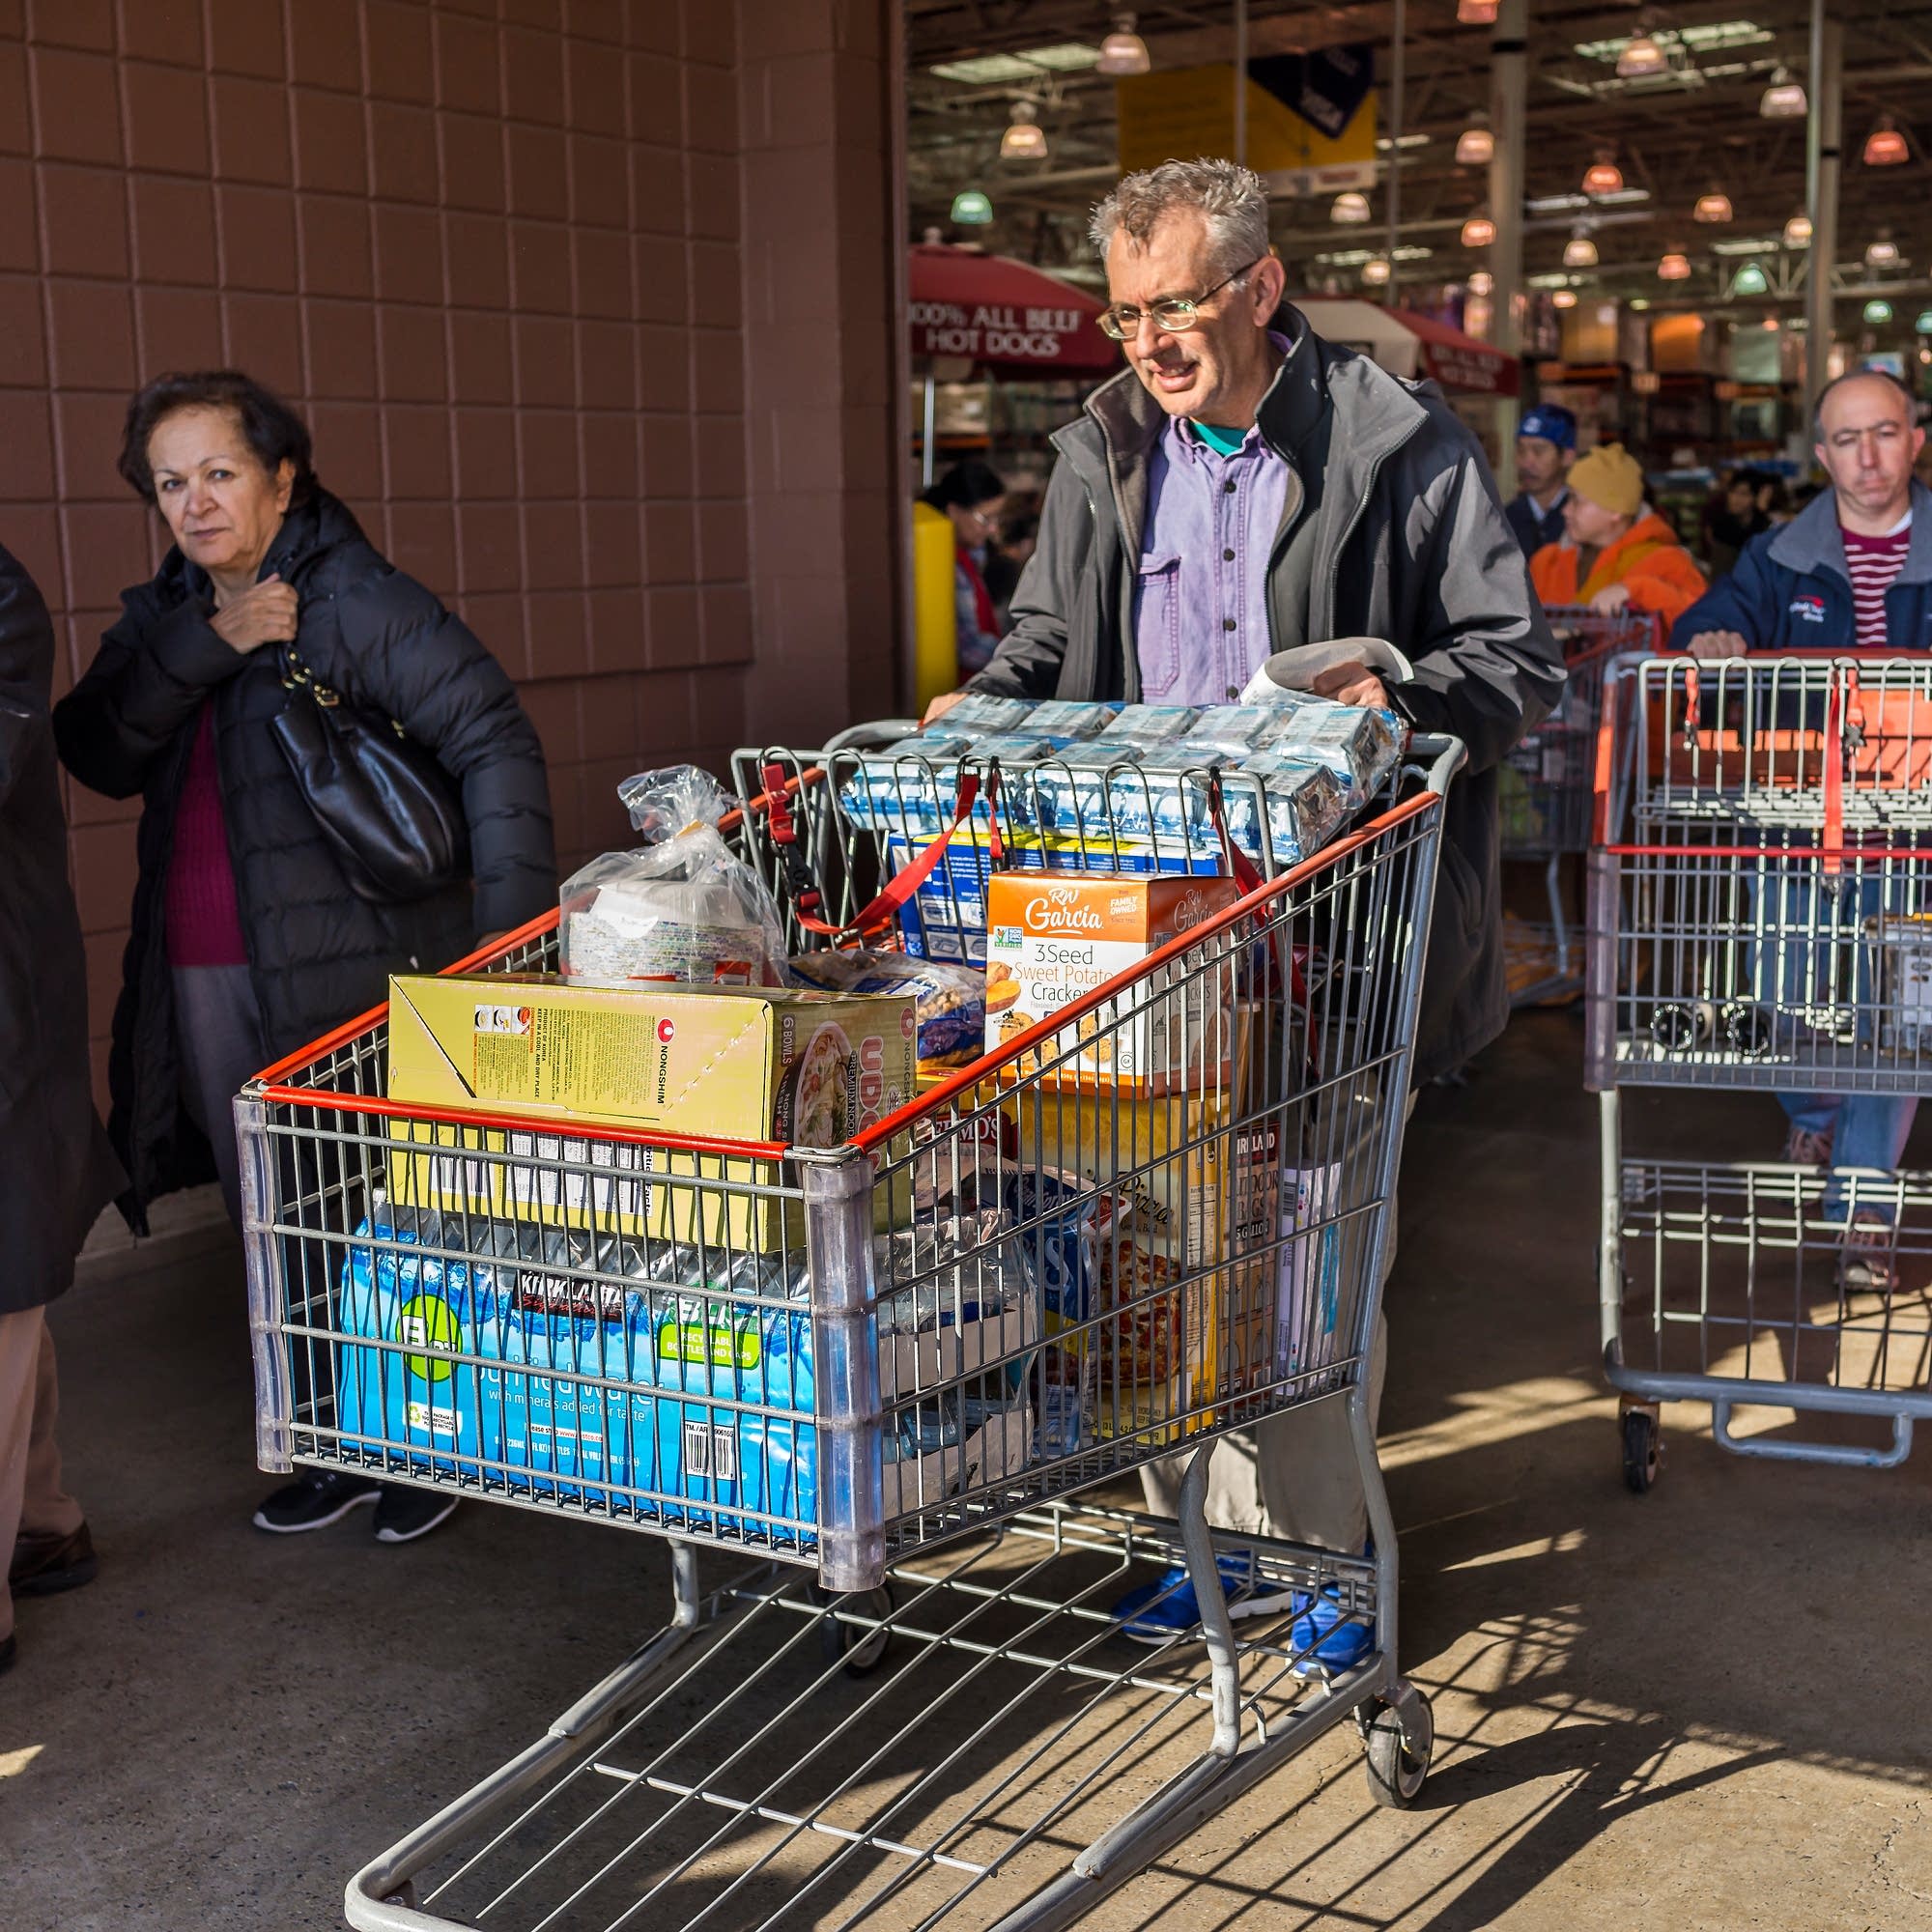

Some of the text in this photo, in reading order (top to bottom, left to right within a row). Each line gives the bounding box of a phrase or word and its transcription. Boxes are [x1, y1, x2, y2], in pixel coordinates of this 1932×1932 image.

[972, 306, 1018, 330] ALL
[925, 329, 1061, 357] HOT DOGS
[1048, 888, 1080, 906] RW
[1110, 895, 1138, 907] FAMILY
[1025, 897, 1102, 930] Garcia
[1110, 904, 1137, 915] OWNED
[1014, 961, 1114, 984] Sweet Potato
[1032, 982, 1090, 1002] Cracker
[781, 1017, 794, 1064] 6 BOWLS
[657, 1045, 668, 1104] NONGSHIM
[847, 1053, 857, 1138] PREMIUM NOOD
[859, 1037, 883, 1142] UDO
[1236, 1132, 1275, 1155] IRLAD
[1241, 1220, 1269, 1239] GLLO
[522, 1273, 621, 1307] KIRKLAD
[681, 1331, 733, 1348] RECYLABL
[709, 1346, 727, 1358] ND
[471, 1355, 665, 1406] puriied wae
[489, 1388, 645, 1422] wih mneras aded fr tate
[545, 1427, 558, 1435] shp
